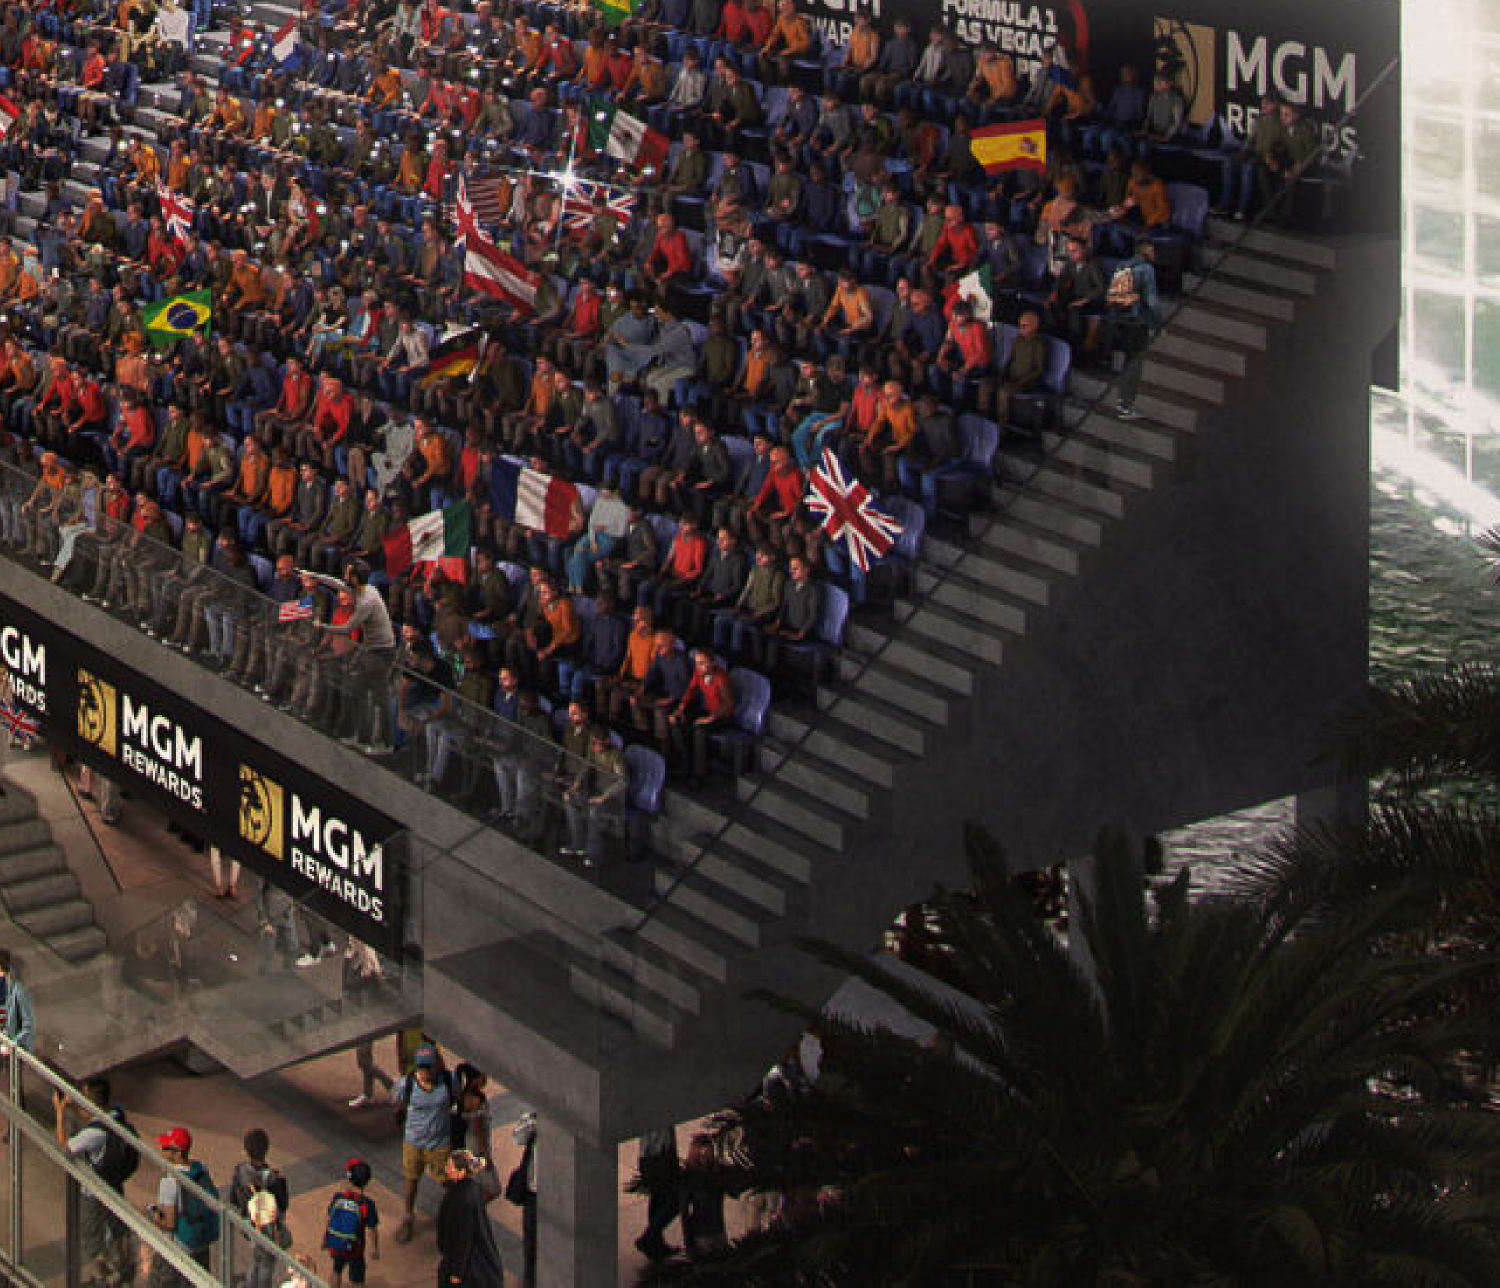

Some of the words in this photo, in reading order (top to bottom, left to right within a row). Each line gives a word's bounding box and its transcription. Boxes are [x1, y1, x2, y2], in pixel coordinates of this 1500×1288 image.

[1046, 7, 1058, 33] 1
[1227, 32, 1356, 114] MGM
[122, 693, 203, 781] MGM
[122, 743, 203, 810] REWARDS
[291, 793, 384, 892] MGM
[291, 846, 384, 922] REWARDS
